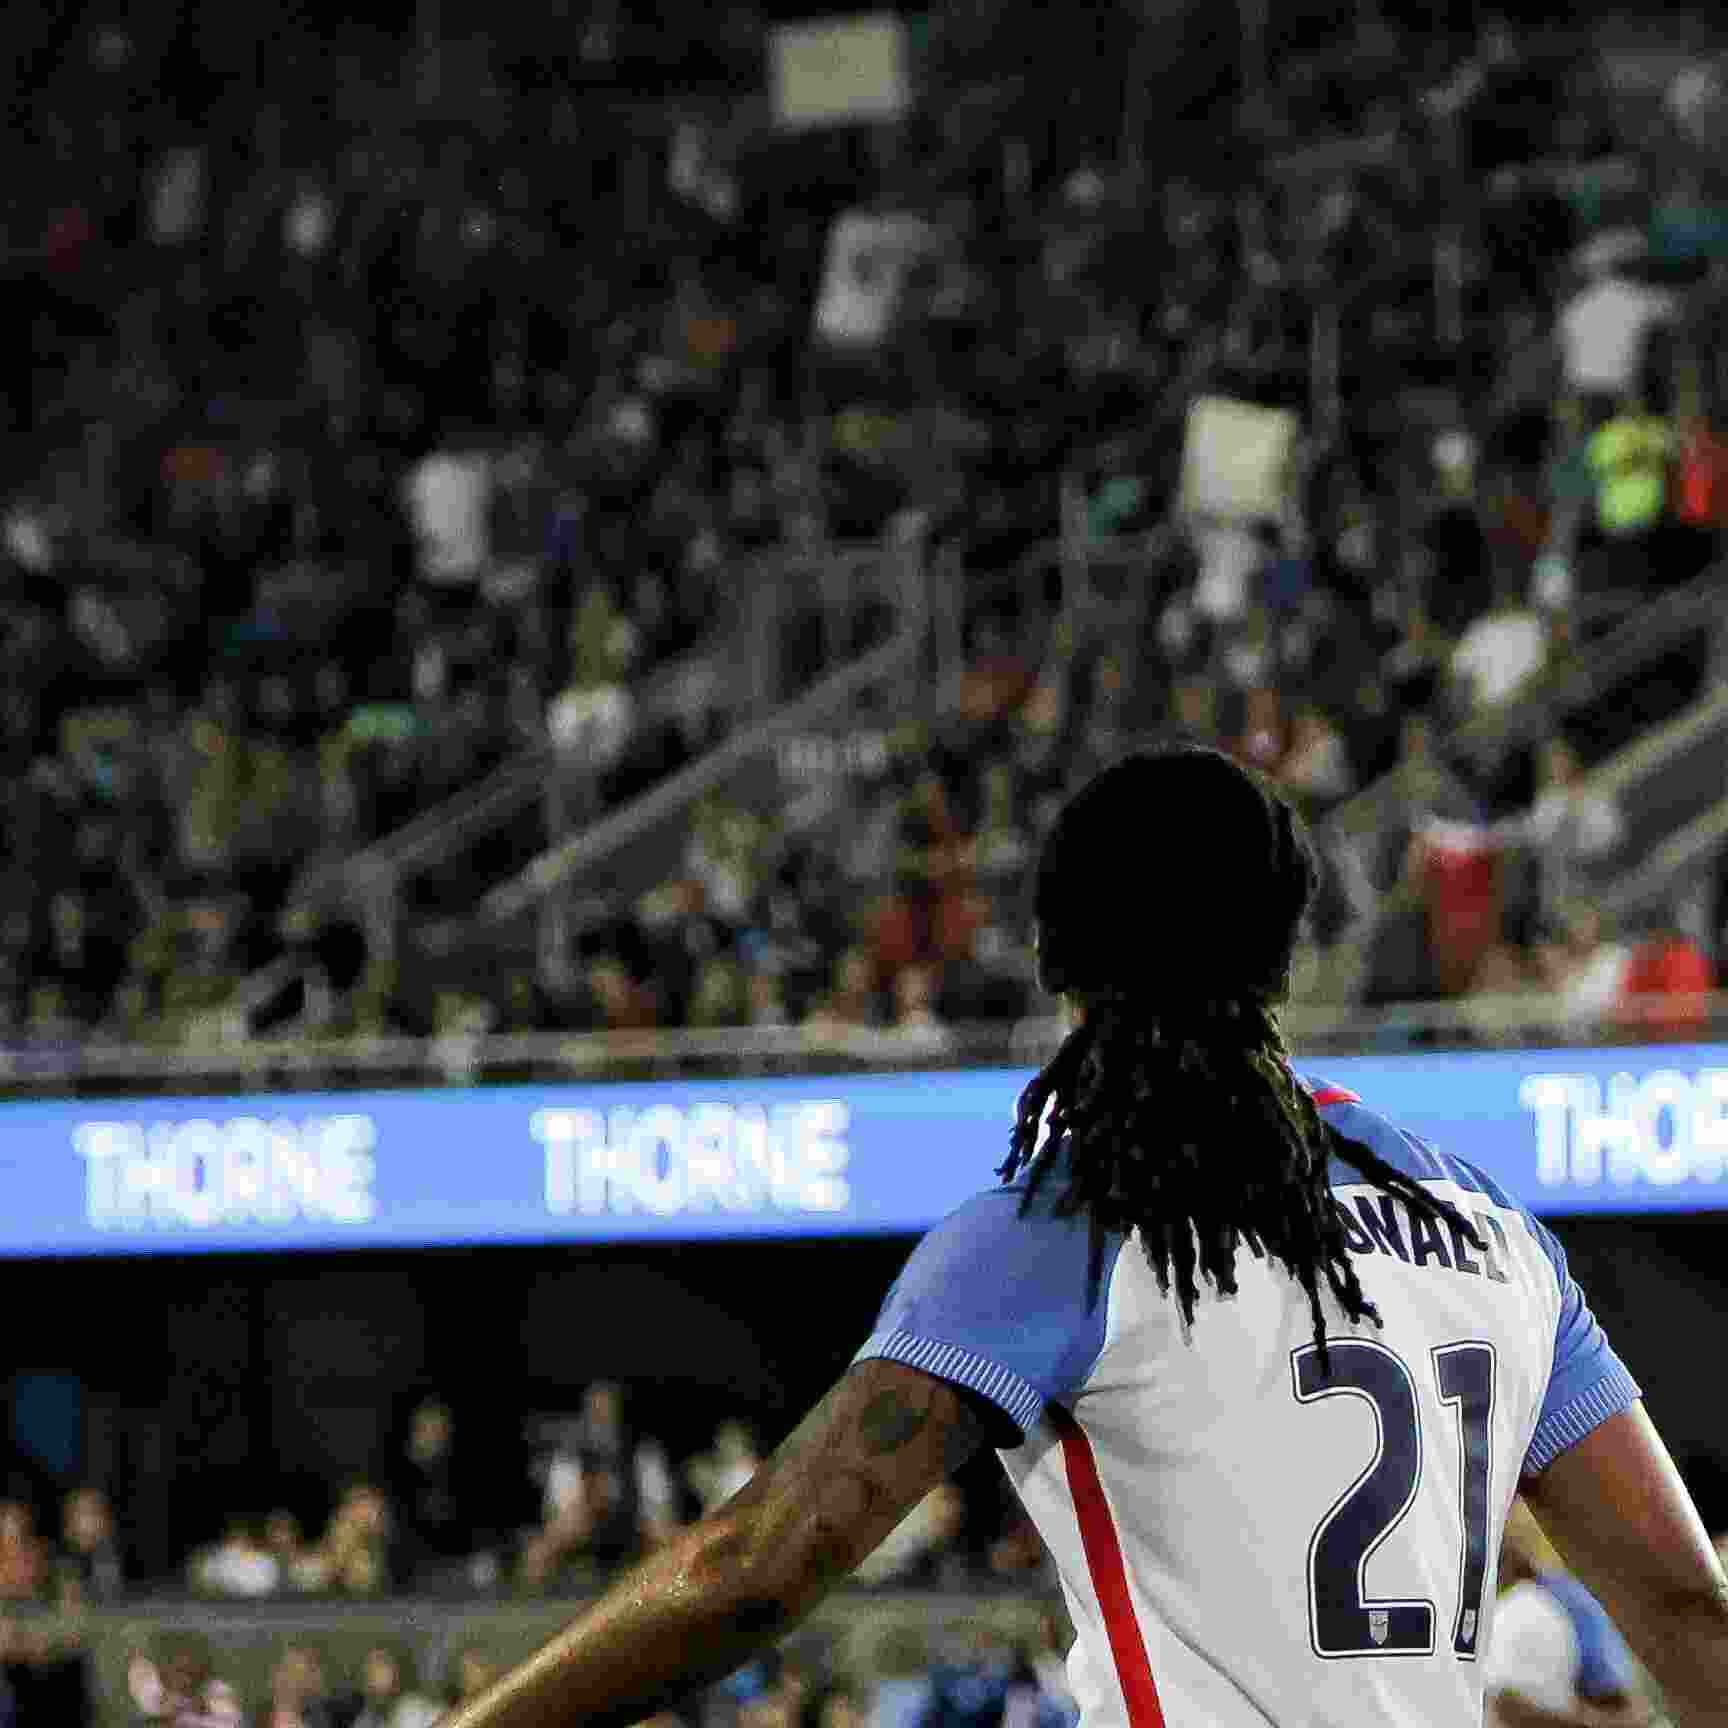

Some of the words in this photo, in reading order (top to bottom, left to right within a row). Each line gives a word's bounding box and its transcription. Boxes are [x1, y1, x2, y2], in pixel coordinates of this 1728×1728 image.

[73, 1115, 378, 1229] THORNE
[531, 1101, 850, 1214] THORNE
[1291, 1338, 1496, 1662] 21
